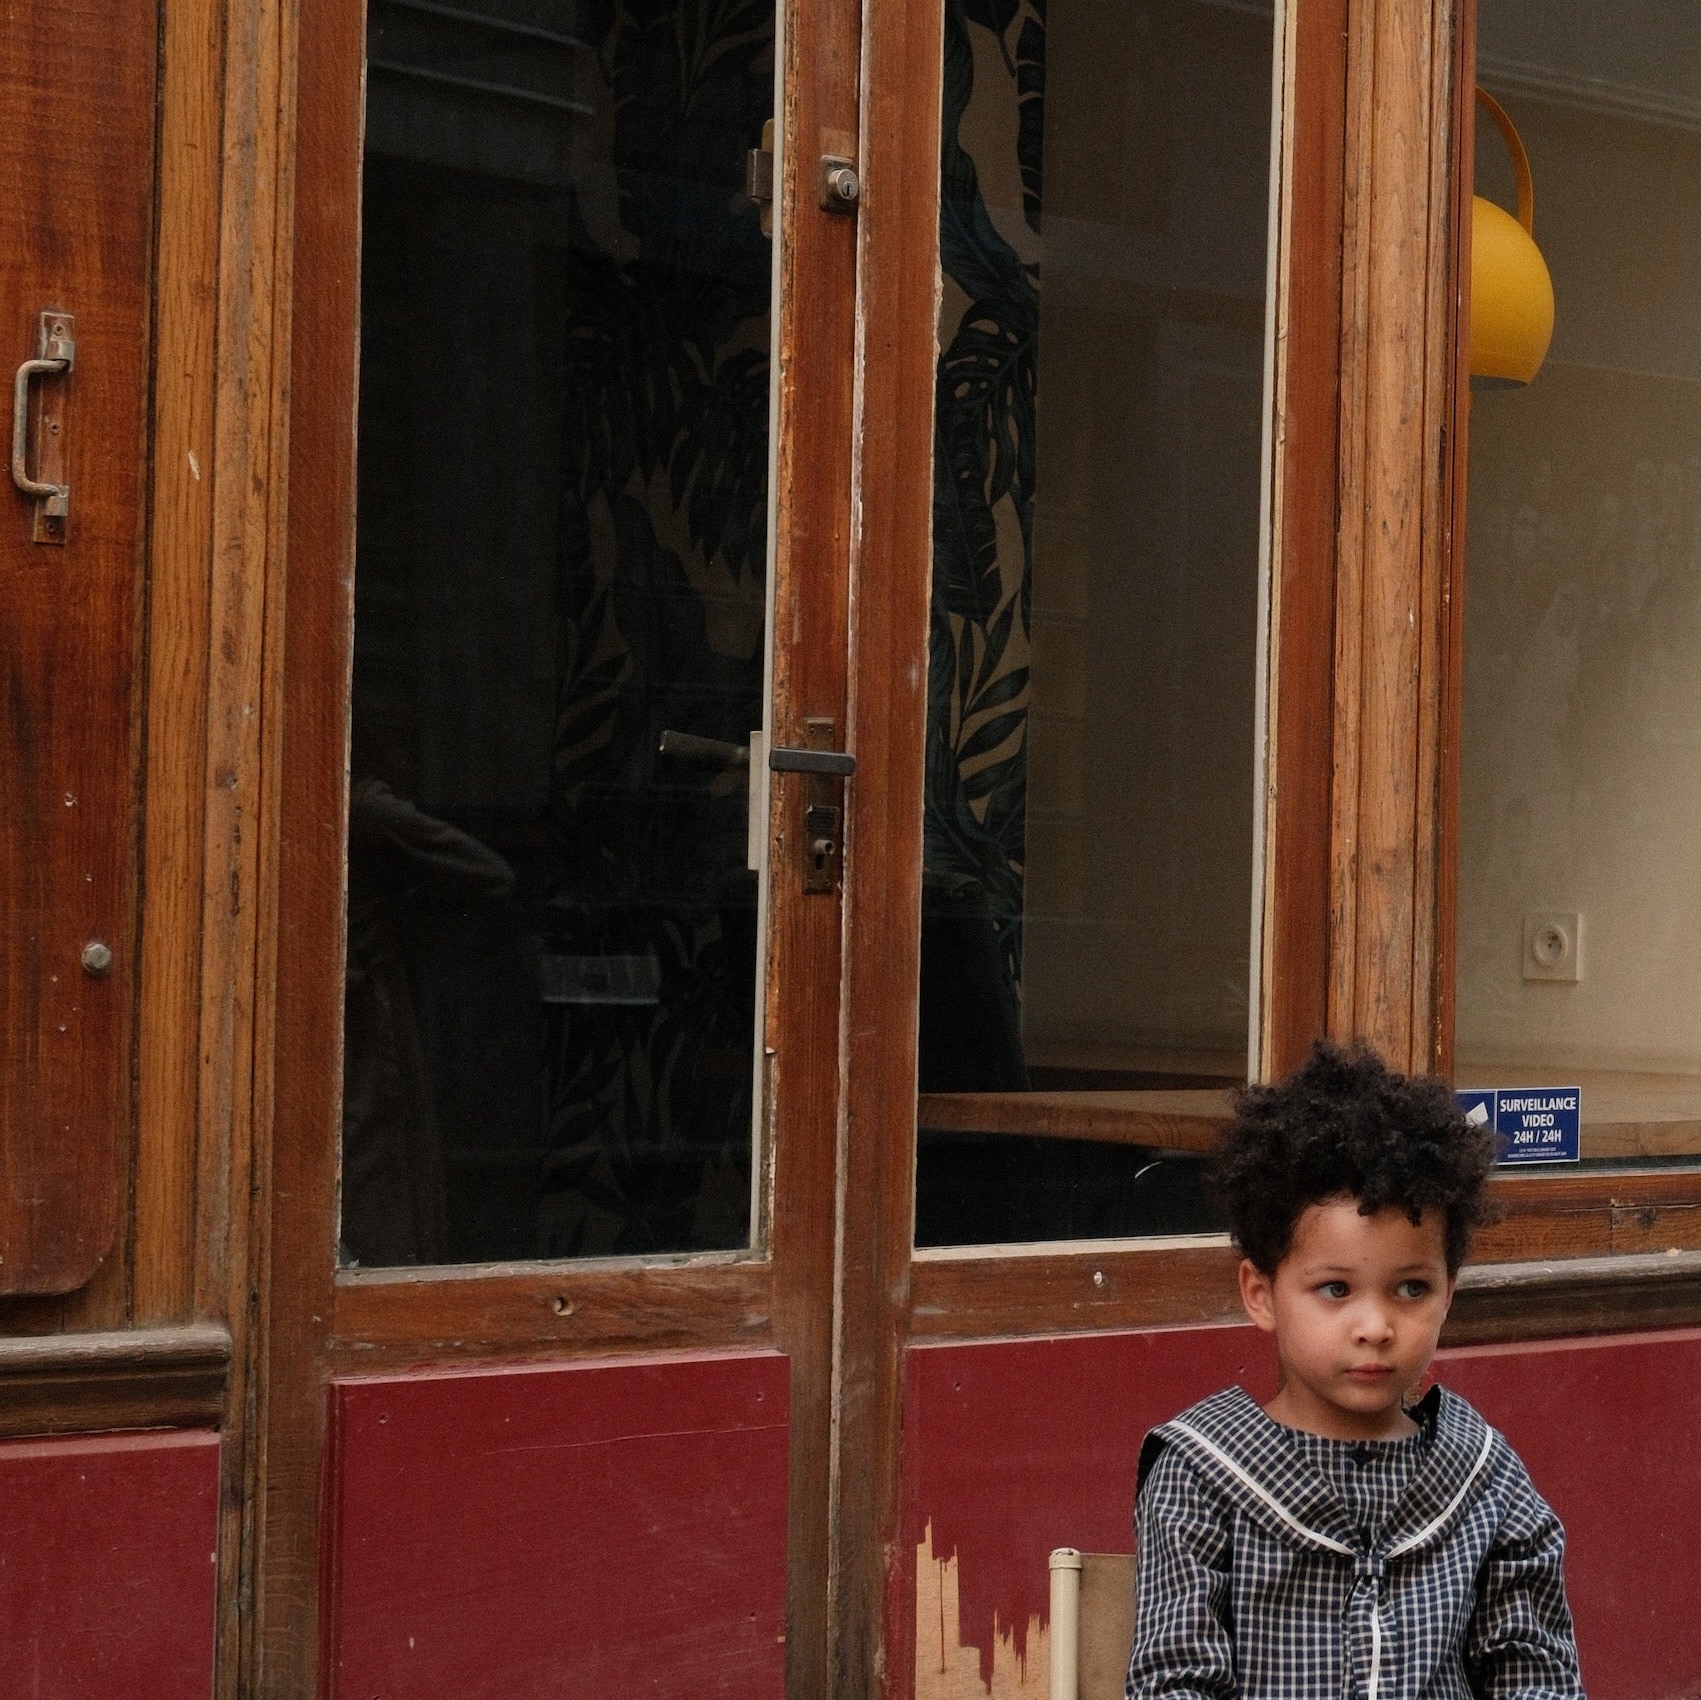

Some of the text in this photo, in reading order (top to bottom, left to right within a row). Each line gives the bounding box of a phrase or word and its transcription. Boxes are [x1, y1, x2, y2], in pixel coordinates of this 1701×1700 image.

[1500, 1097, 1576, 1112] SURVEILLANCE
[1522, 1114, 1554, 1127] VIDEO
[1513, 1130, 1534, 1144] 24H
[1542, 1129, 1562, 1143] 24H
